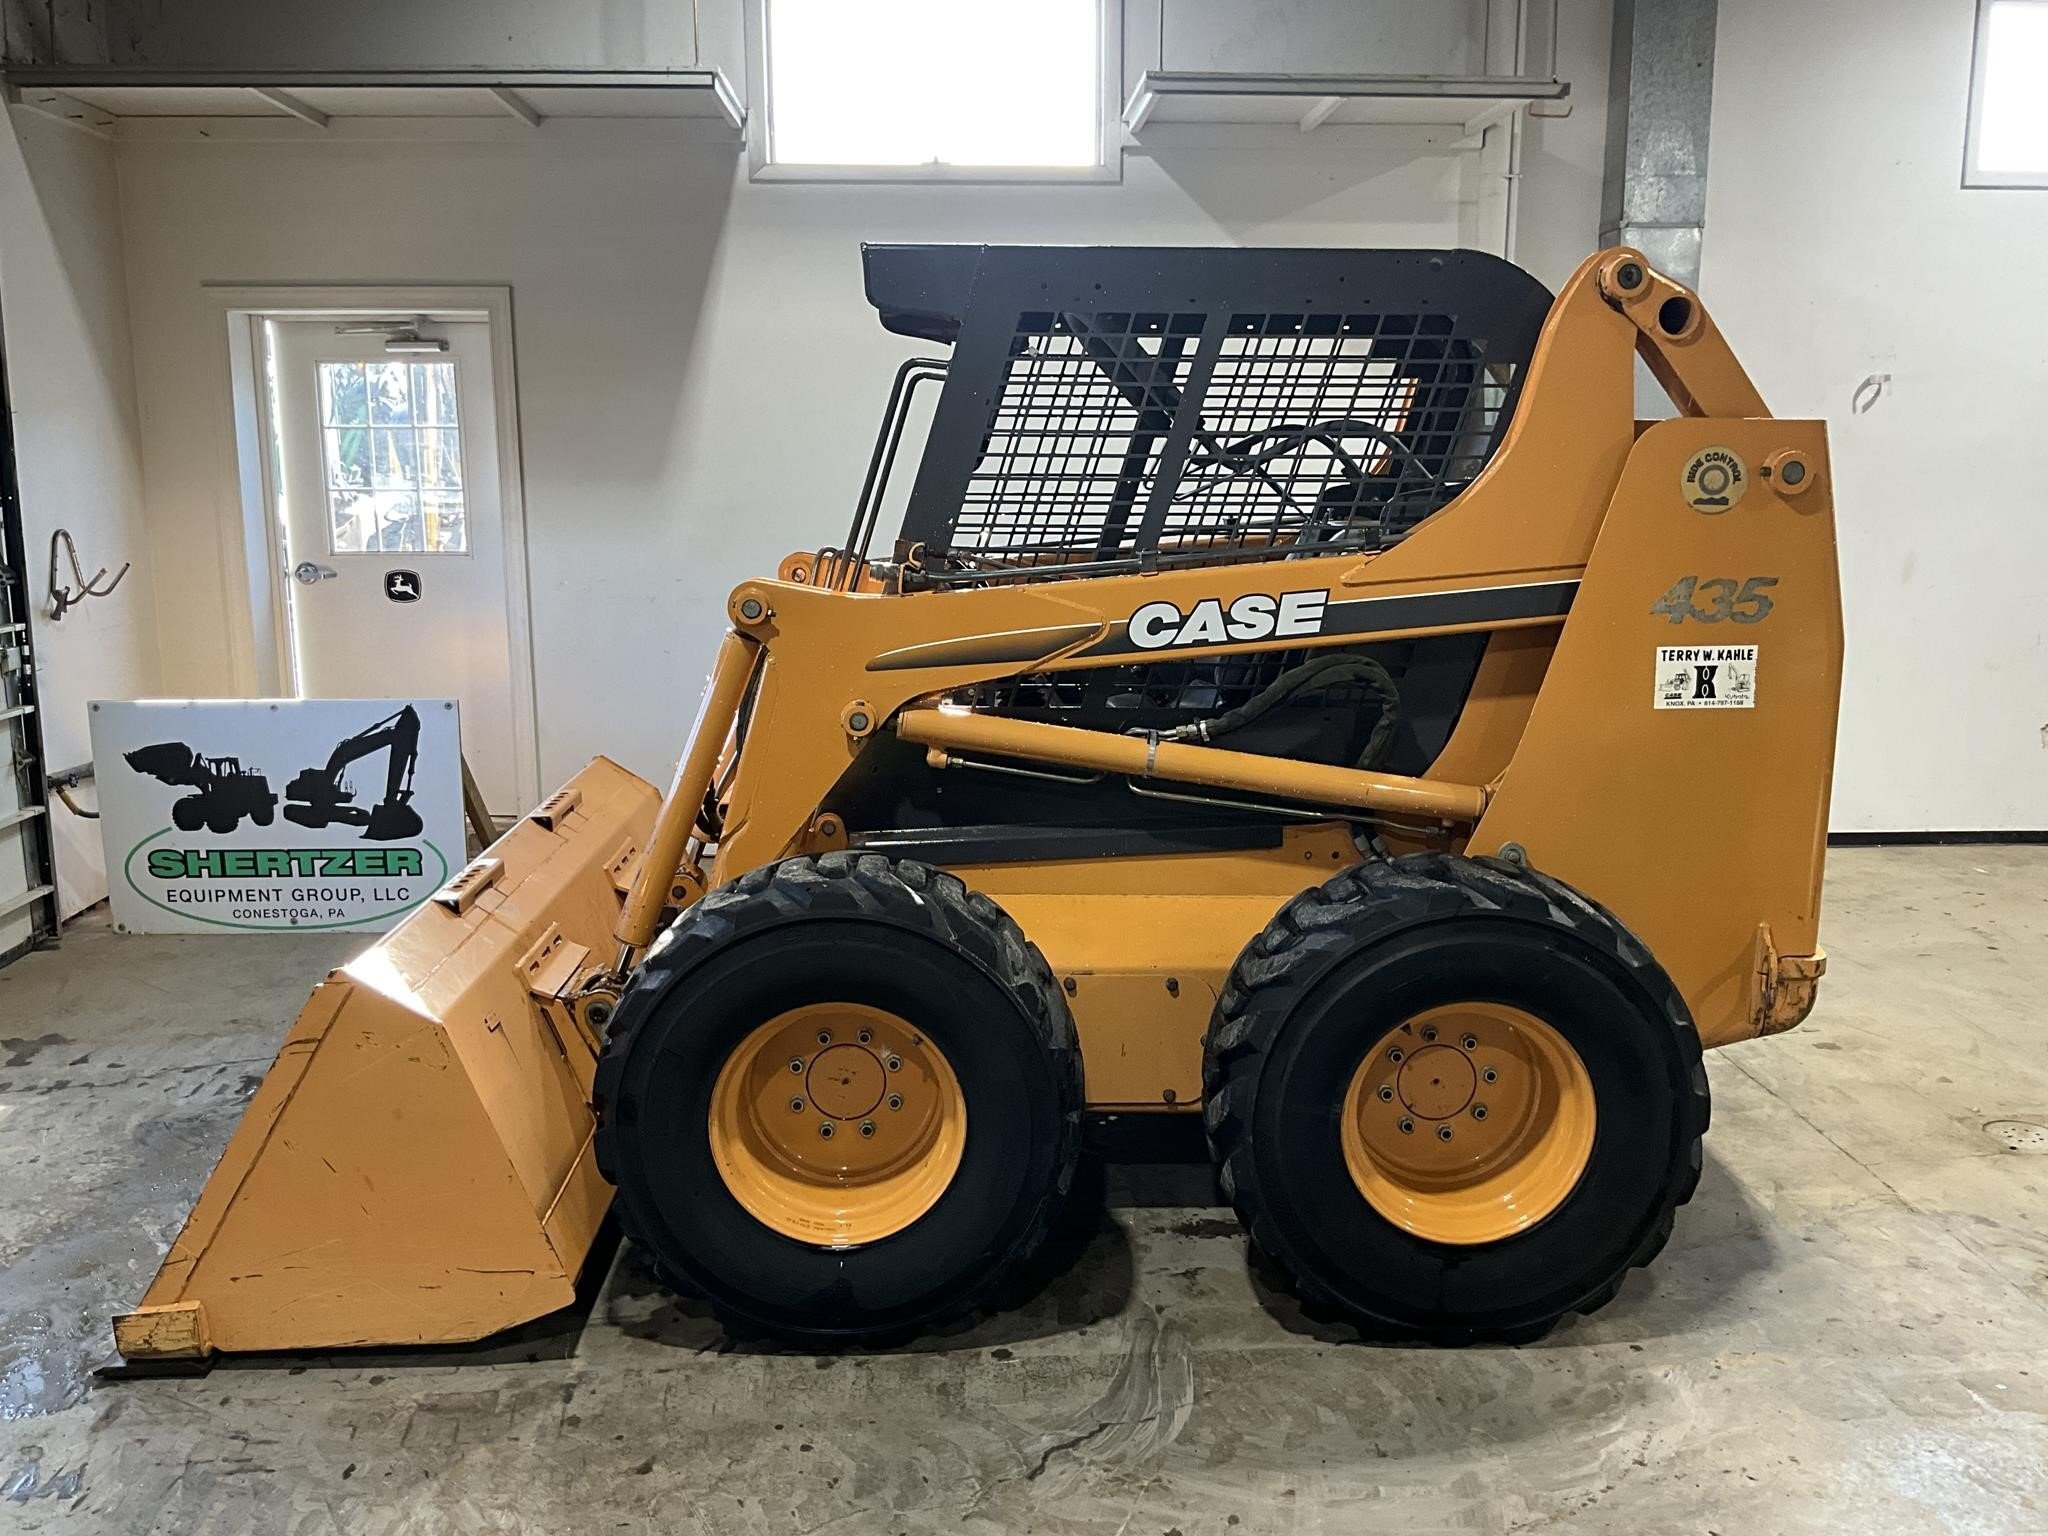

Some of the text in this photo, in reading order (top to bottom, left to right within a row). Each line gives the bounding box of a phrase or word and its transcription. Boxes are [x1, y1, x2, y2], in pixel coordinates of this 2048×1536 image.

[1687, 452, 1742, 485] RIDE CONTROL
[1650, 575, 1780, 625] 435
[1128, 588, 1330, 650] CASE
[1661, 648, 1754, 662] TERRY W. KAHLE
[148, 848, 424, 878] SHERTZER
[167, 887, 410, 904] EQUIPMENT GROUP, LLC
[232, 907, 346, 919] CONESTOGA, PA
